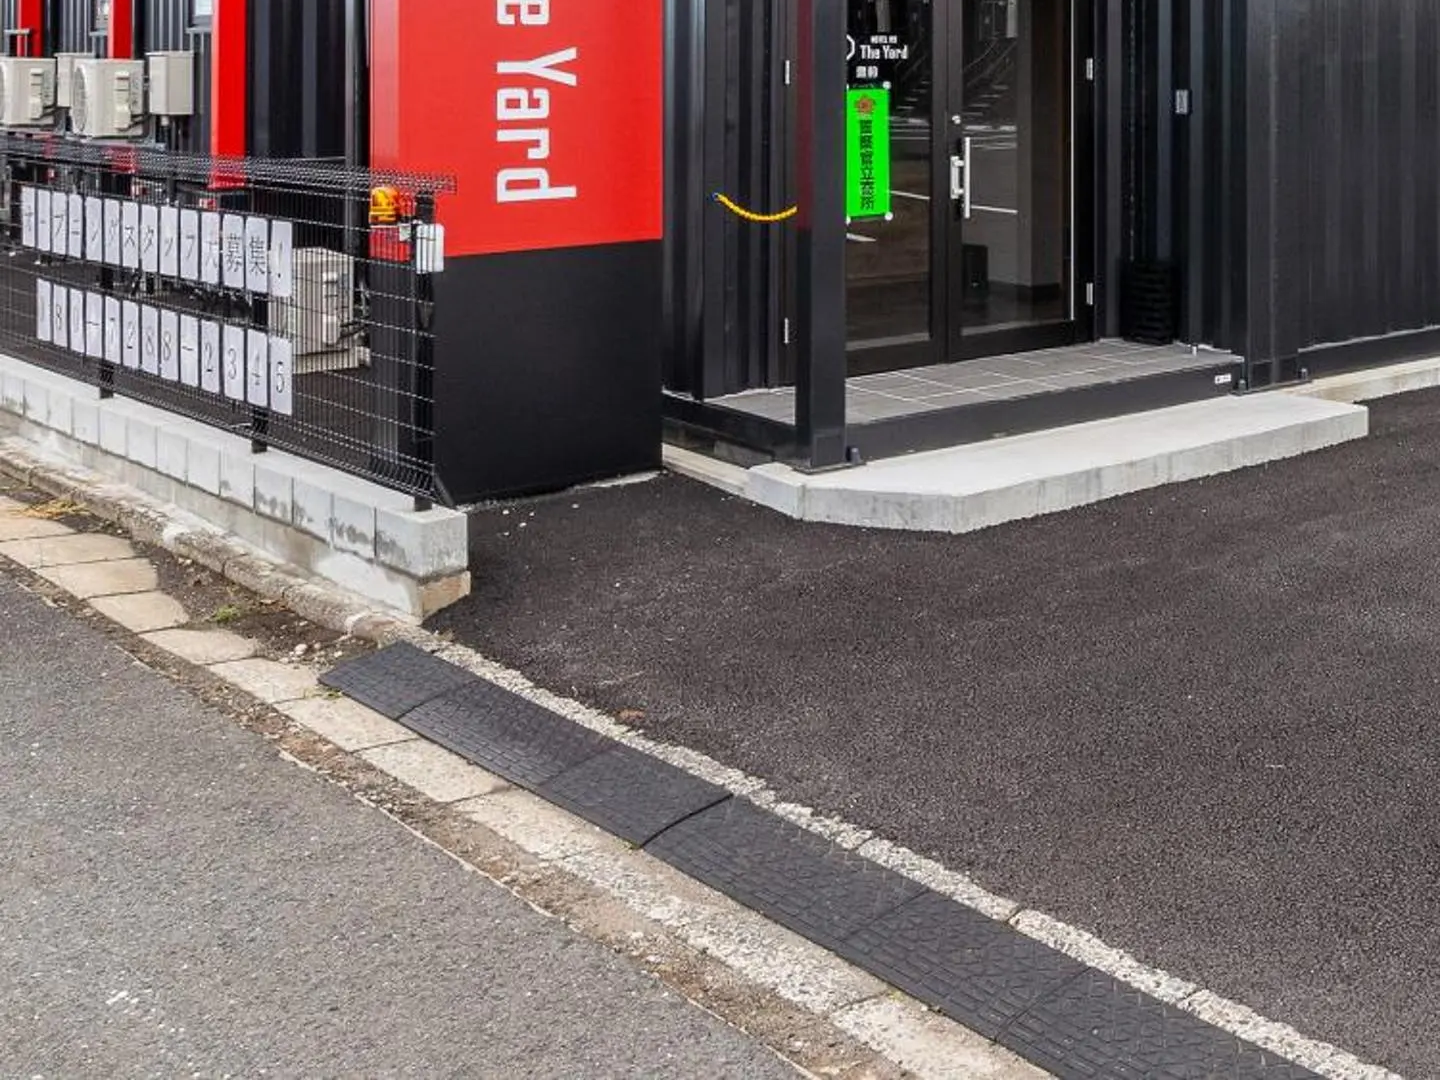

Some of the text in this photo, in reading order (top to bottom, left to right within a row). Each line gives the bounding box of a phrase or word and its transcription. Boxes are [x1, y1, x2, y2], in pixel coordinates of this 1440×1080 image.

[860, 44, 909, 60] The Yard
[496, 47, 577, 204] Yard
